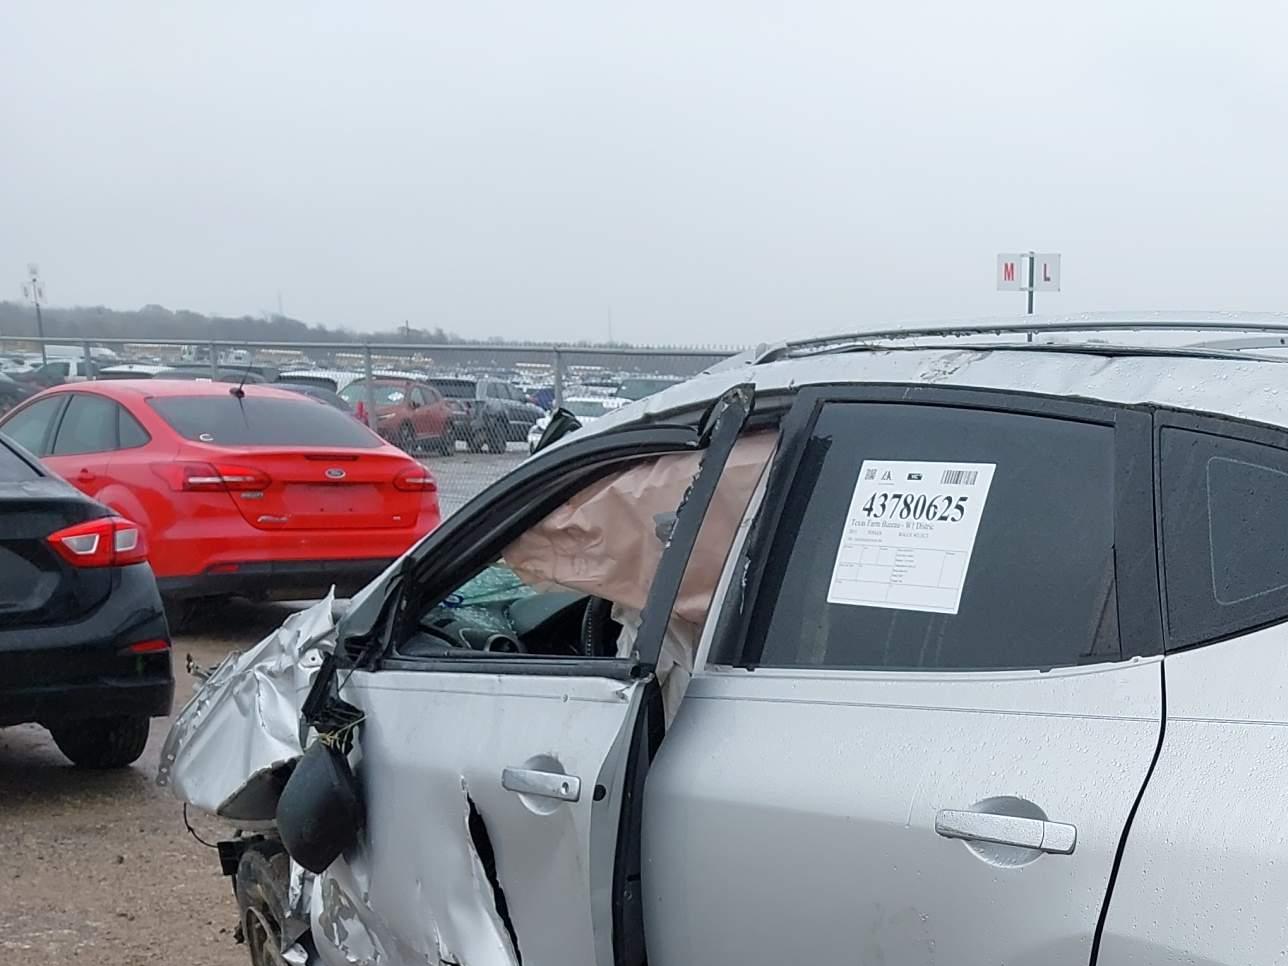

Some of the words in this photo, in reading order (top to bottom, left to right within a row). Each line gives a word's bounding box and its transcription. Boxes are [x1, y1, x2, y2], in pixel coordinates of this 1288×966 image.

[1004, 262, 1015, 281] M
[1043, 263, 1051, 282] L
[862, 492, 969, 522] 43780625
